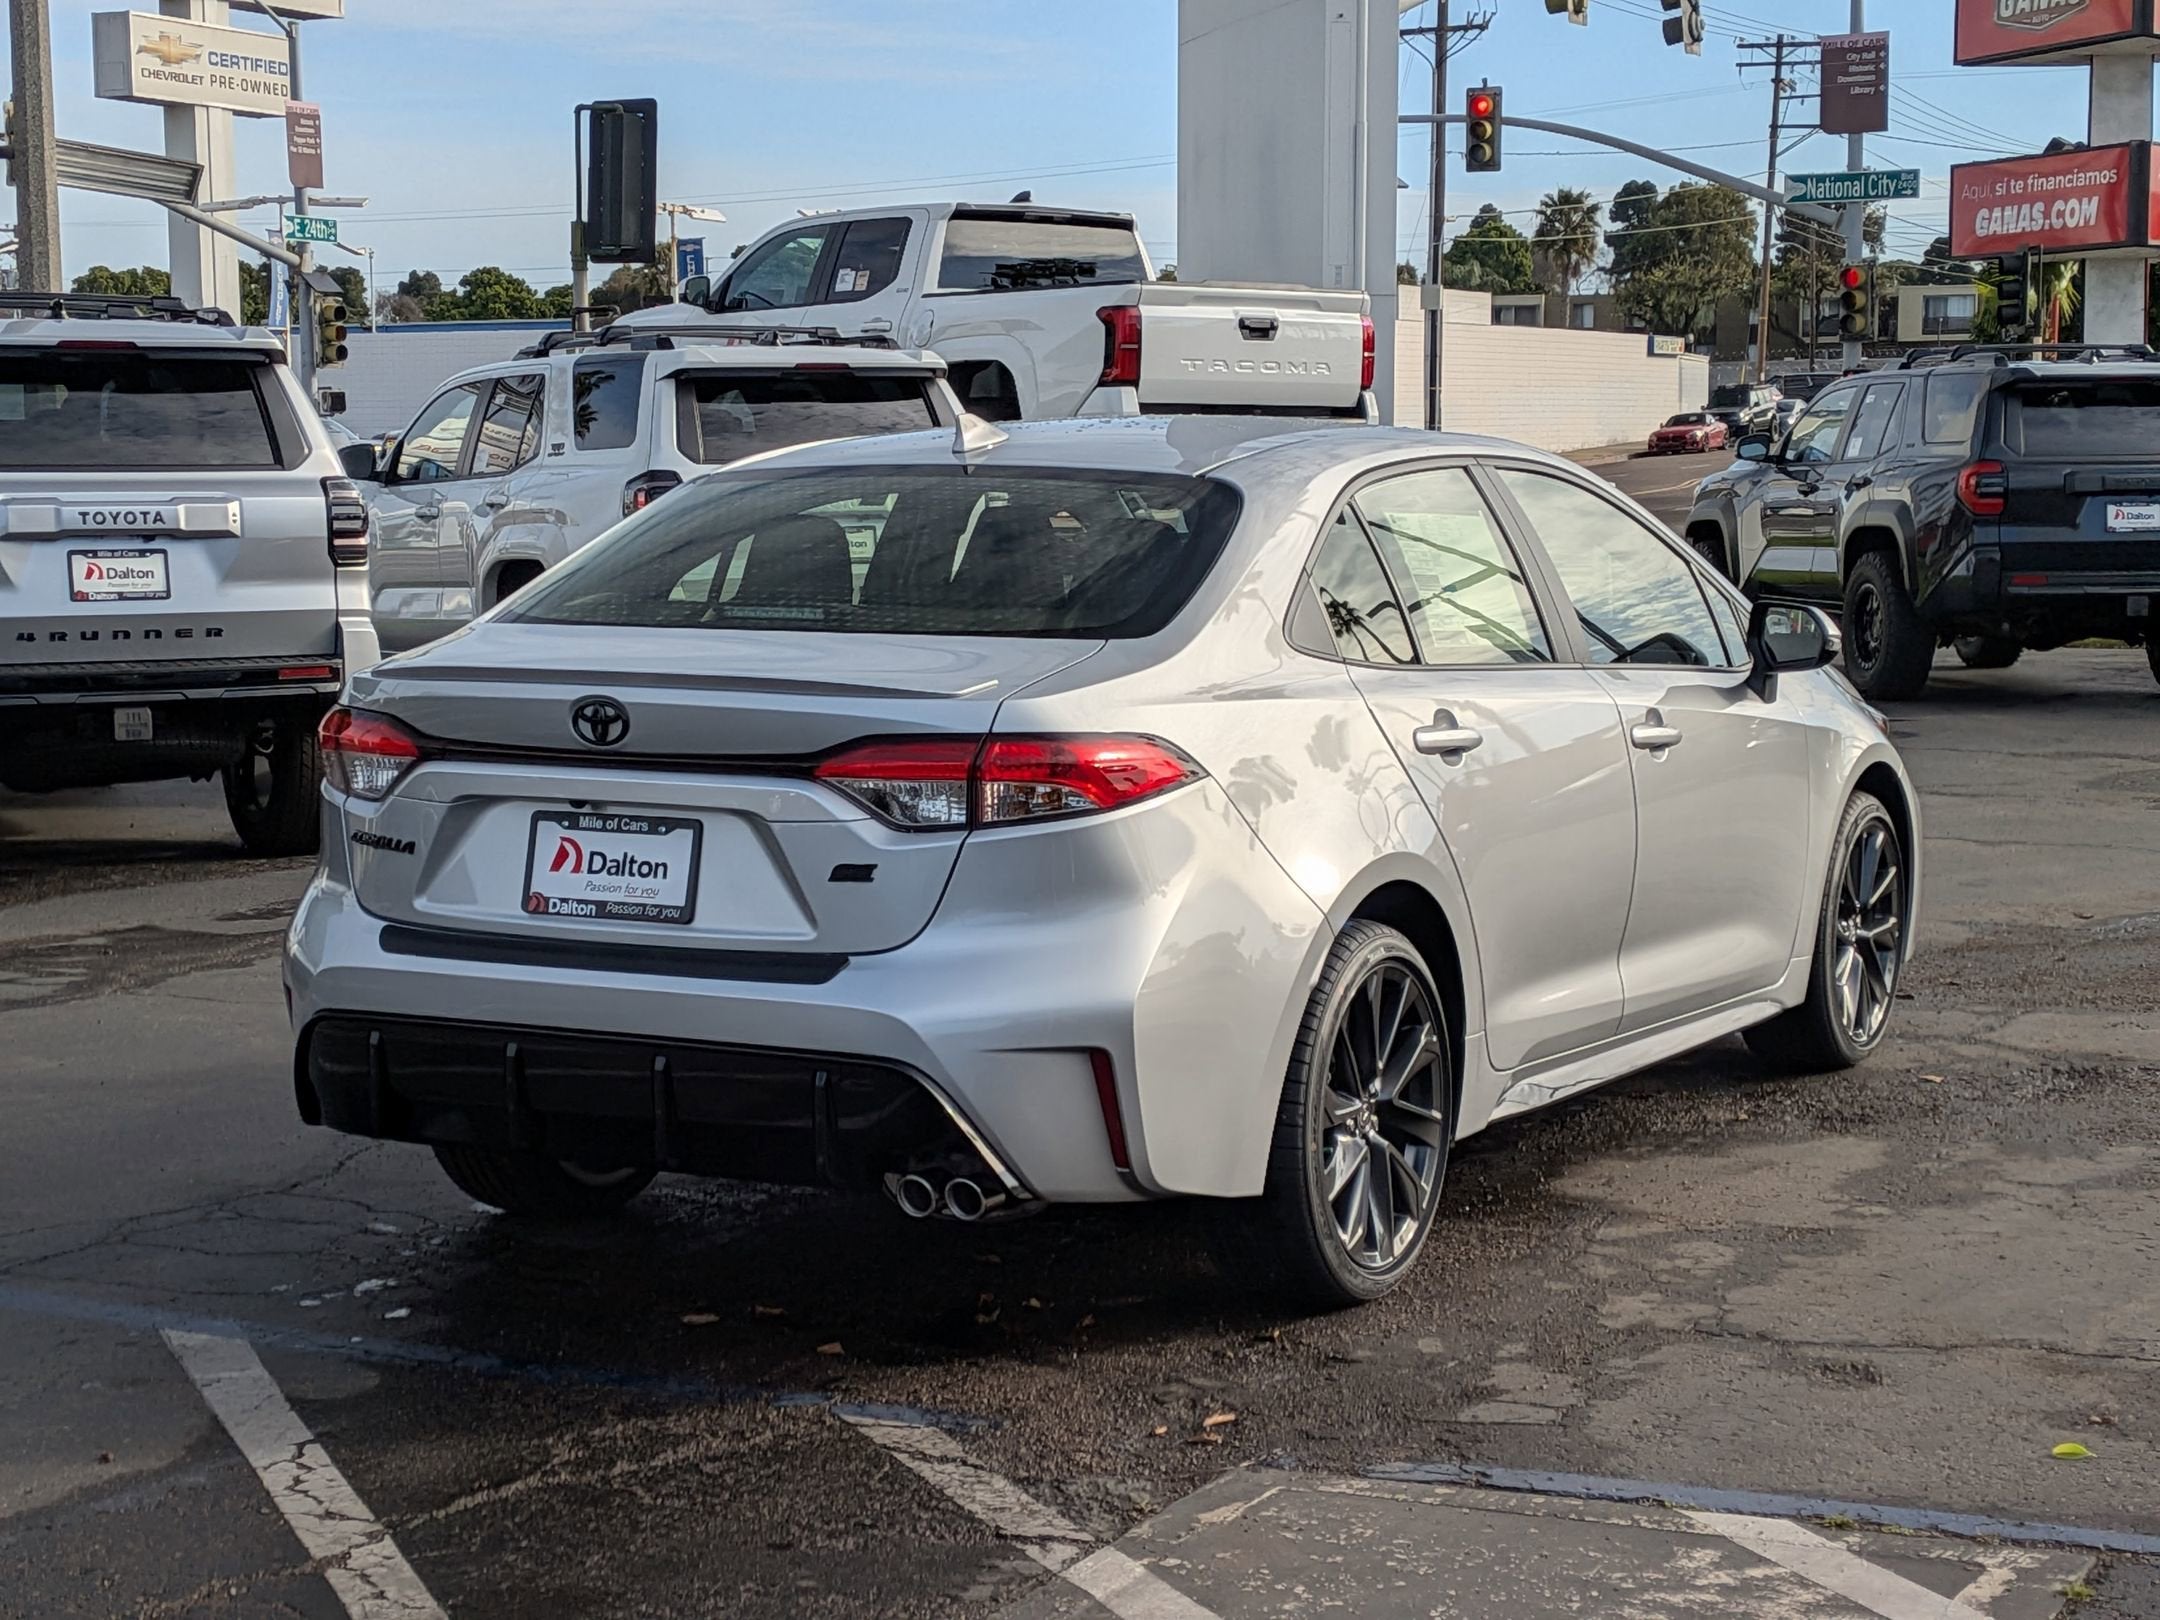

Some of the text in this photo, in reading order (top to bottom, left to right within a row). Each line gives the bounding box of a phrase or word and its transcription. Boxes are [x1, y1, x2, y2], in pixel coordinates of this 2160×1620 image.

[208, 50, 288, 77] CERTIFIED
[141, 67, 205, 86] CHEVROLET
[210, 74, 288, 97] PRE-OWNED
[1806, 174, 1898, 200] National City
[2010, 178, 2024, 194] te
[2027, 168, 2118, 193] financiamos
[1975, 195, 2099, 238] GANAS.COM
[304, 219, 328, 240] 24th
[1180, 358, 1331, 376] TACOMA
[78, 510, 166, 526] TOYOTA
[2126, 512, 2156, 520] Dalton
[106, 566, 155, 580] Dalton
[88, 592, 119, 600] Dalton
[578, 815, 649, 832] Mile of Cars
[586, 849, 669, 880] Dalton
[583, 879, 660, 897] Passion for you
[548, 897, 597, 917] Dalton
[604, 901, 681, 919] Passion for you
